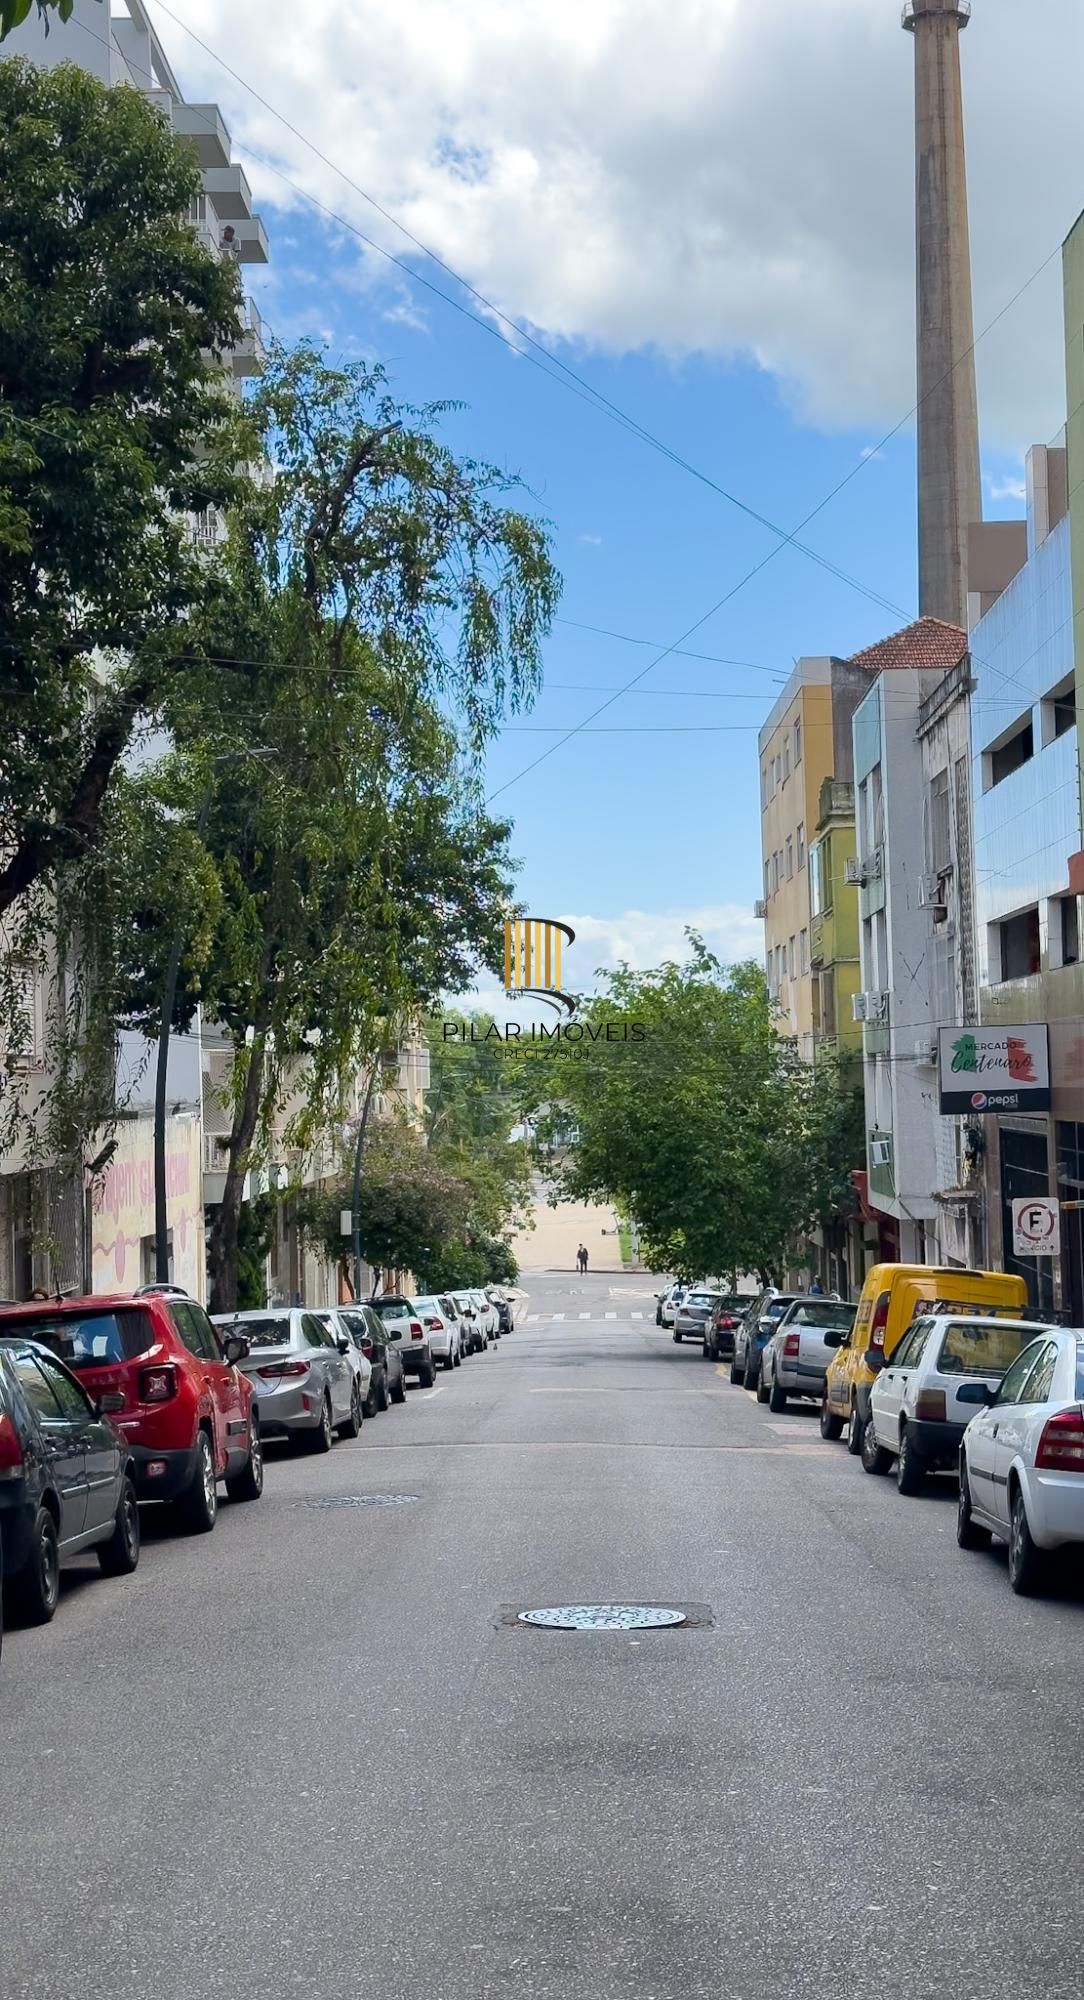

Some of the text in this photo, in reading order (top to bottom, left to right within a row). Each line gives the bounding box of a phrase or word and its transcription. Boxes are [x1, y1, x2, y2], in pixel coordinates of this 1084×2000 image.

[964, 1041, 1017, 1051] MERCADO
[950, 1050, 1033, 1073] Centenaro
[987, 1093, 1019, 1107] pepsi
